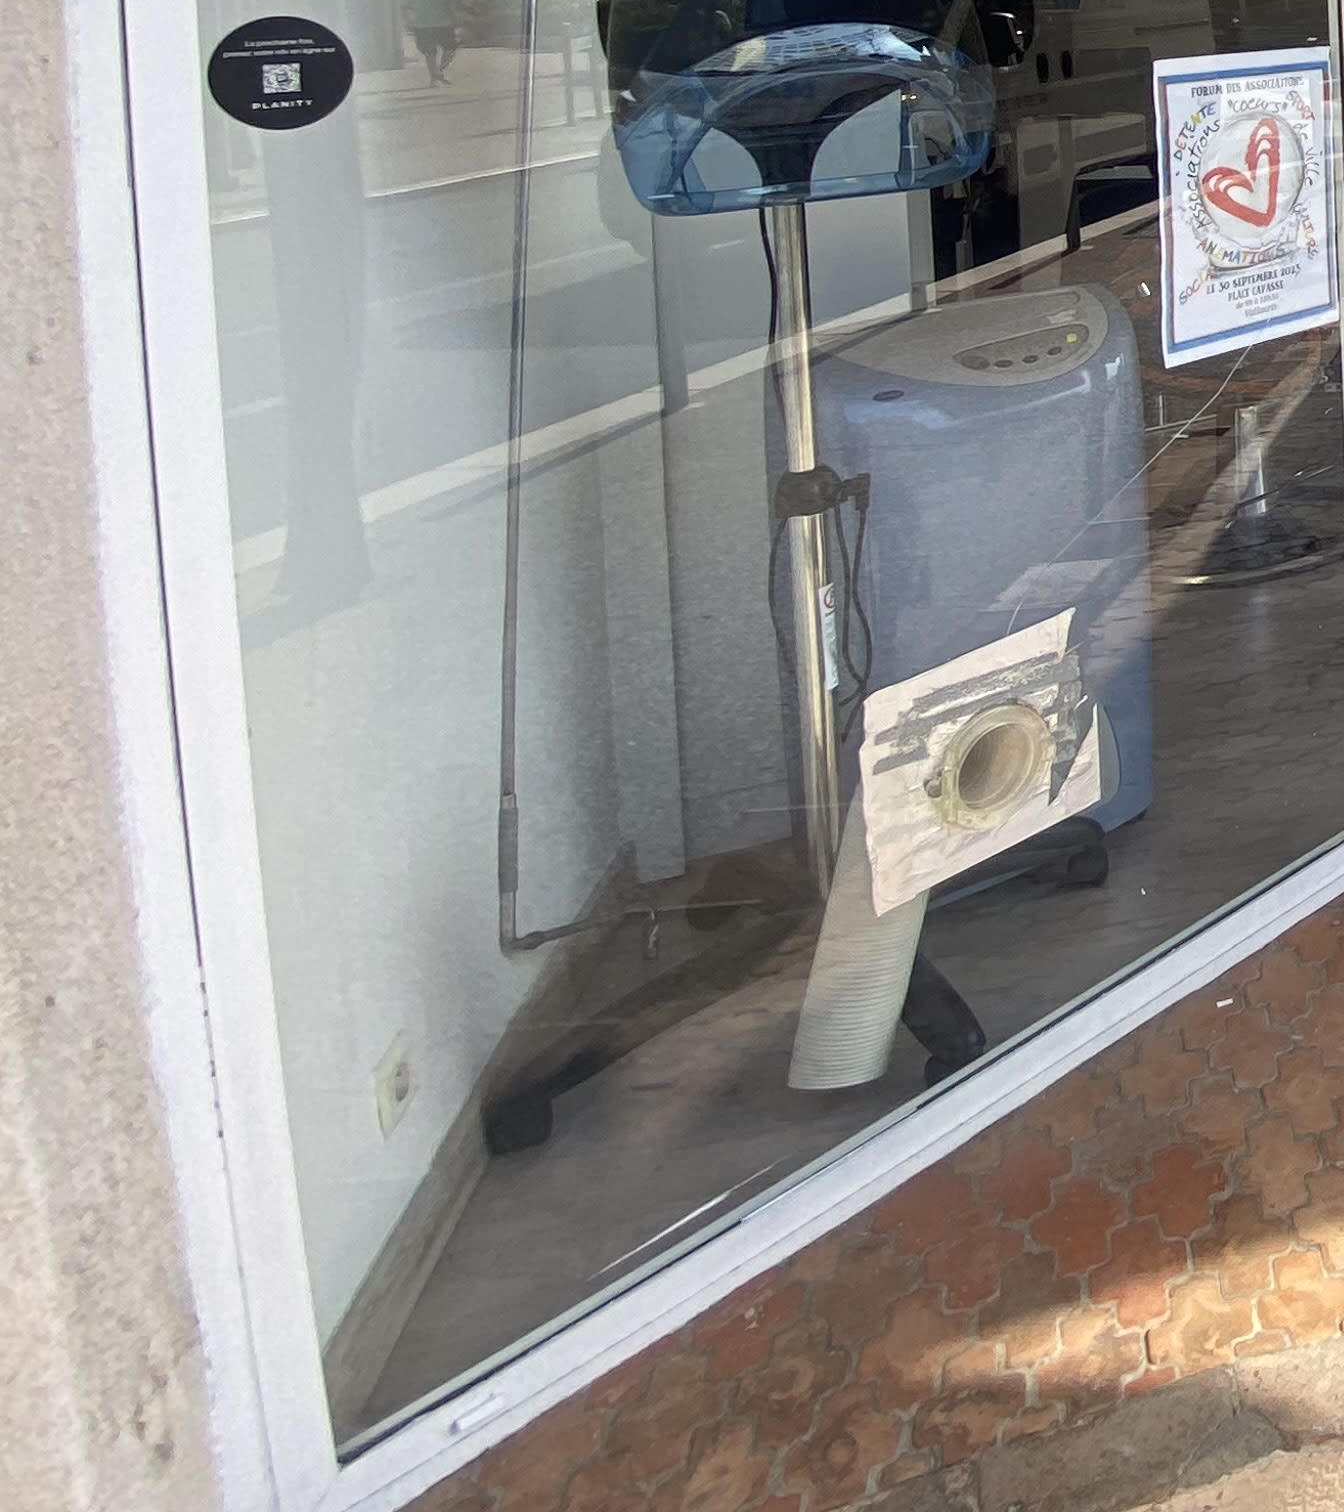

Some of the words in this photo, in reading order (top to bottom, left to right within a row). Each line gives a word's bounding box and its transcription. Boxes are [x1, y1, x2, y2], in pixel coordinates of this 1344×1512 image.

[1191, 85, 1222, 97] FORUM
[1226, 83, 1241, 94] DES
[252, 99, 313, 109] PLANITY
[1206, 284, 1215, 294] LE
[1232, 268, 1278, 288] SEPTEMBRE
[1228, 288, 1250, 301] PLACE
